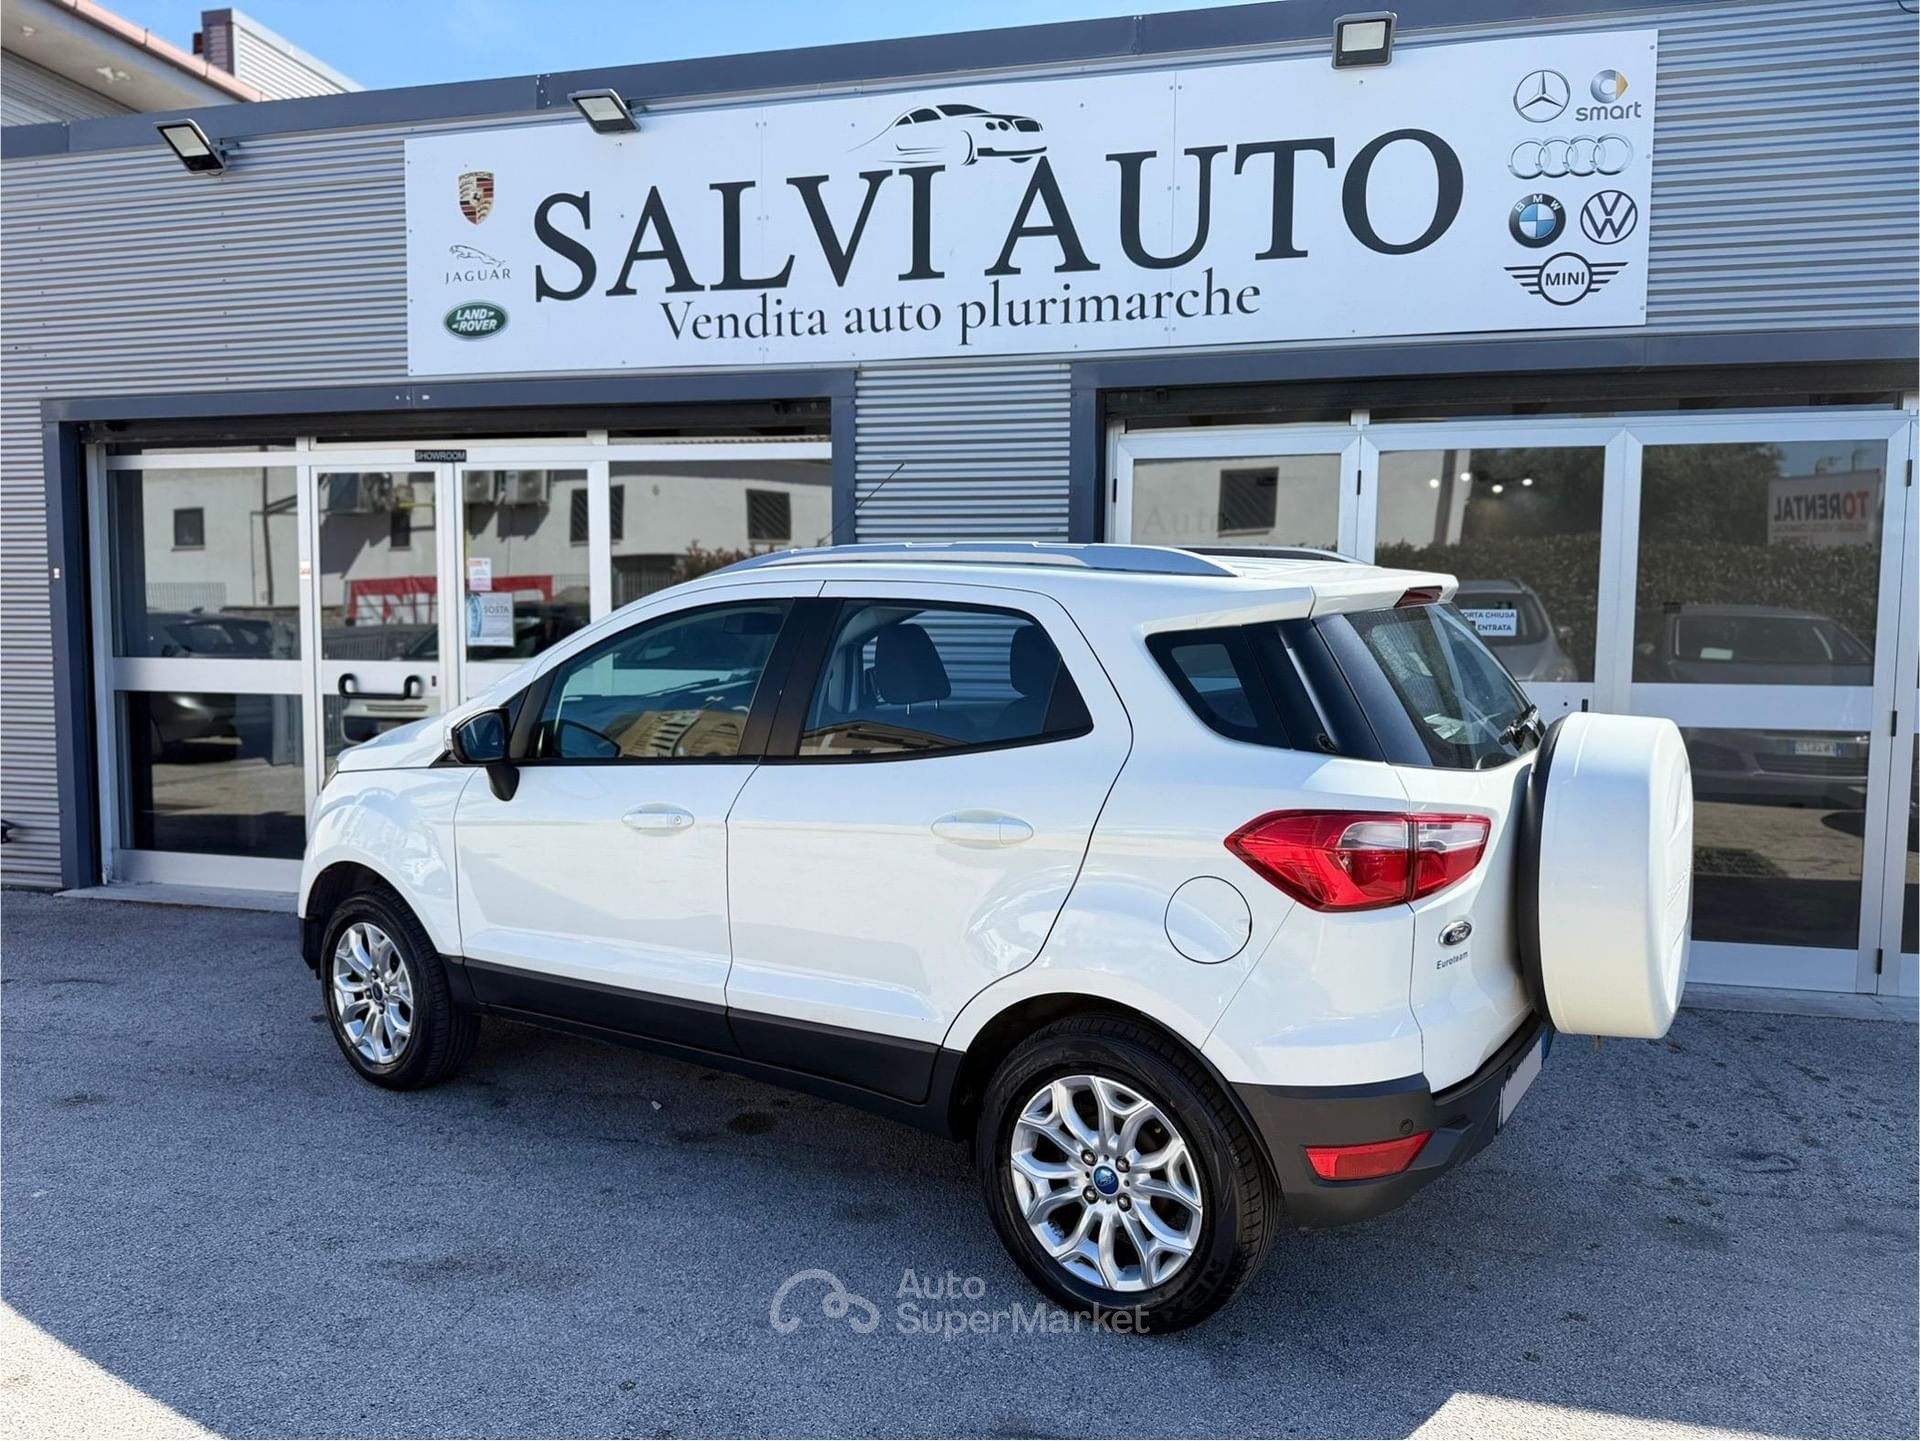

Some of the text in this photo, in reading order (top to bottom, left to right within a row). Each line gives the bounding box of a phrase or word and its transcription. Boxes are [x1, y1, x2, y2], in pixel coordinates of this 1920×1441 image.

[1575, 101, 1642, 122] smart
[535, 127, 1464, 302] SALVI AUTO
[446, 268, 511, 284] JAGUAR
[1544, 271, 1586, 287] MINI
[455, 308, 488, 321] LAND
[661, 267, 1262, 346] Vendita auto plurimarche
[457, 319, 498, 332] ROVER
[415, 451, 466, 461] SHOWROOM
[1463, 611, 1515, 619] ORTA CHIUSA
[1477, 623, 1512, 631] ENTRATA
[1436, 951, 1468, 970] Euroteam
